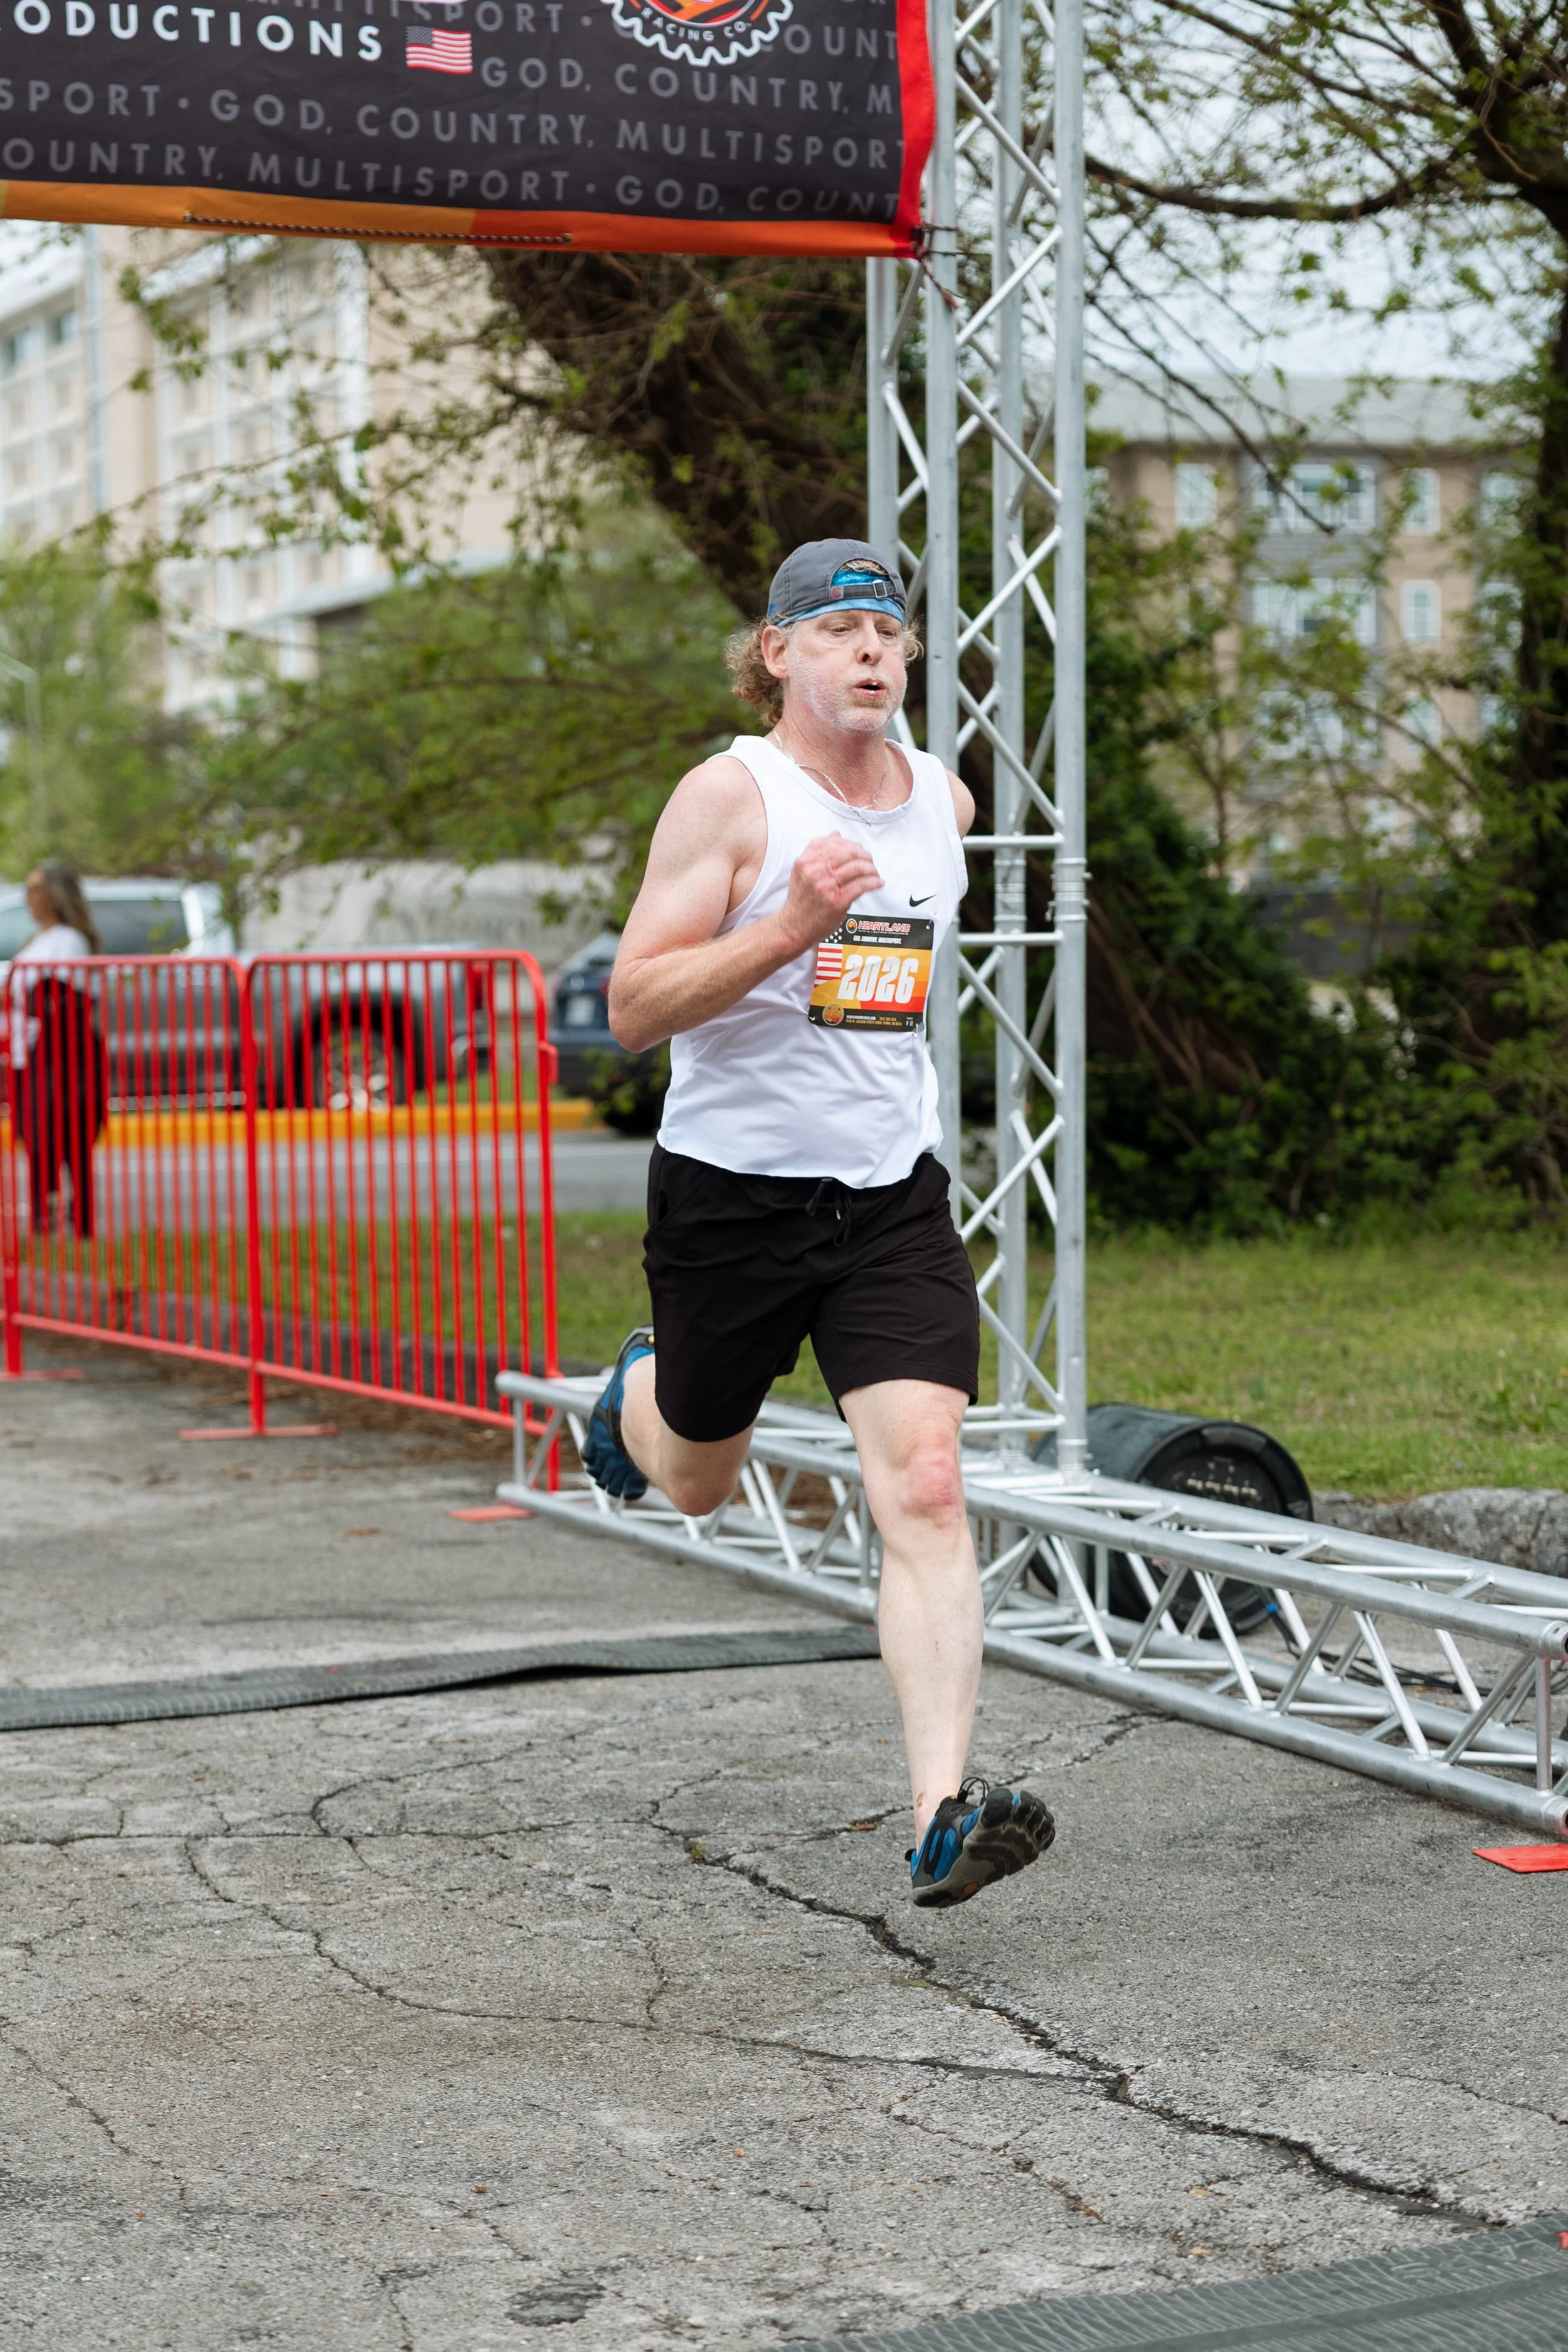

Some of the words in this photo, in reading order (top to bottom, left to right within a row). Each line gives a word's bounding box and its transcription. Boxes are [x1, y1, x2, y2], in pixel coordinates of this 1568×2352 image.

[640, 7, 715, 41] RACING
[759, 24, 898, 60] OUNT
[480, 56, 591, 92] GOD,
[615, 64, 850, 114] COUNTRY,
[210, 89, 332, 135] GOD,
[357, 104, 594, 149] COUNTRY,
[249, 152, 569, 201] MULTISPORT
[615, 175, 724, 214] GOD,
[858, 920, 911, 933] HEARTLAND
[837, 954, 919, 1004] 2026
